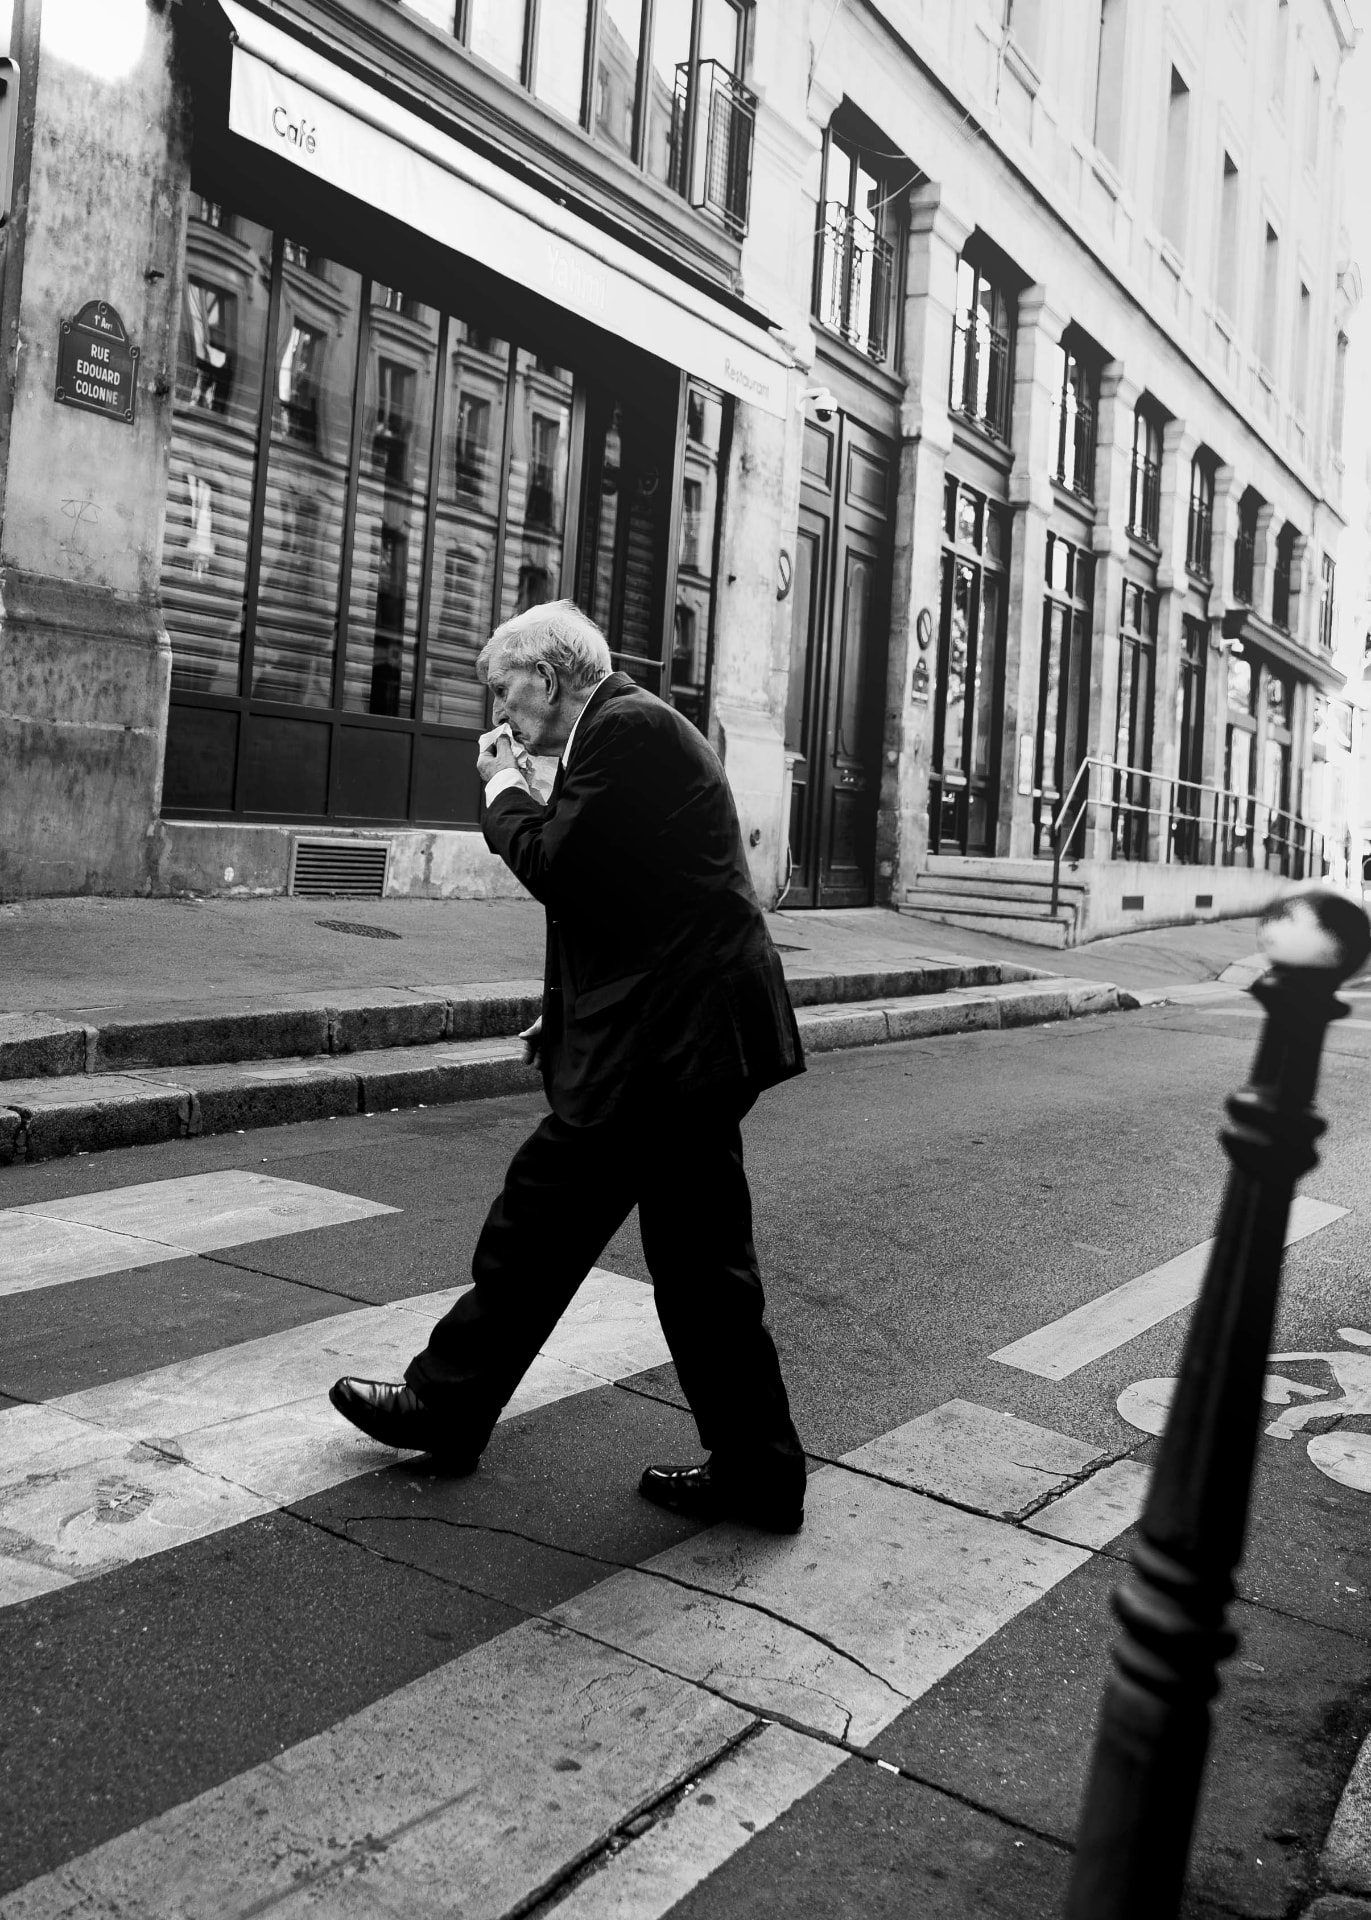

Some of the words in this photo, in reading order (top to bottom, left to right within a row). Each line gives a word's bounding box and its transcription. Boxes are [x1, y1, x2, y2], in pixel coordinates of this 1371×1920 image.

[272, 106, 316, 154] Café
[90, 343, 110, 362] RUE
[76, 359, 120, 385] EDOUARD
[724, 357, 770, 397] Restaurant
[75, 379, 119, 405] COLONNE
